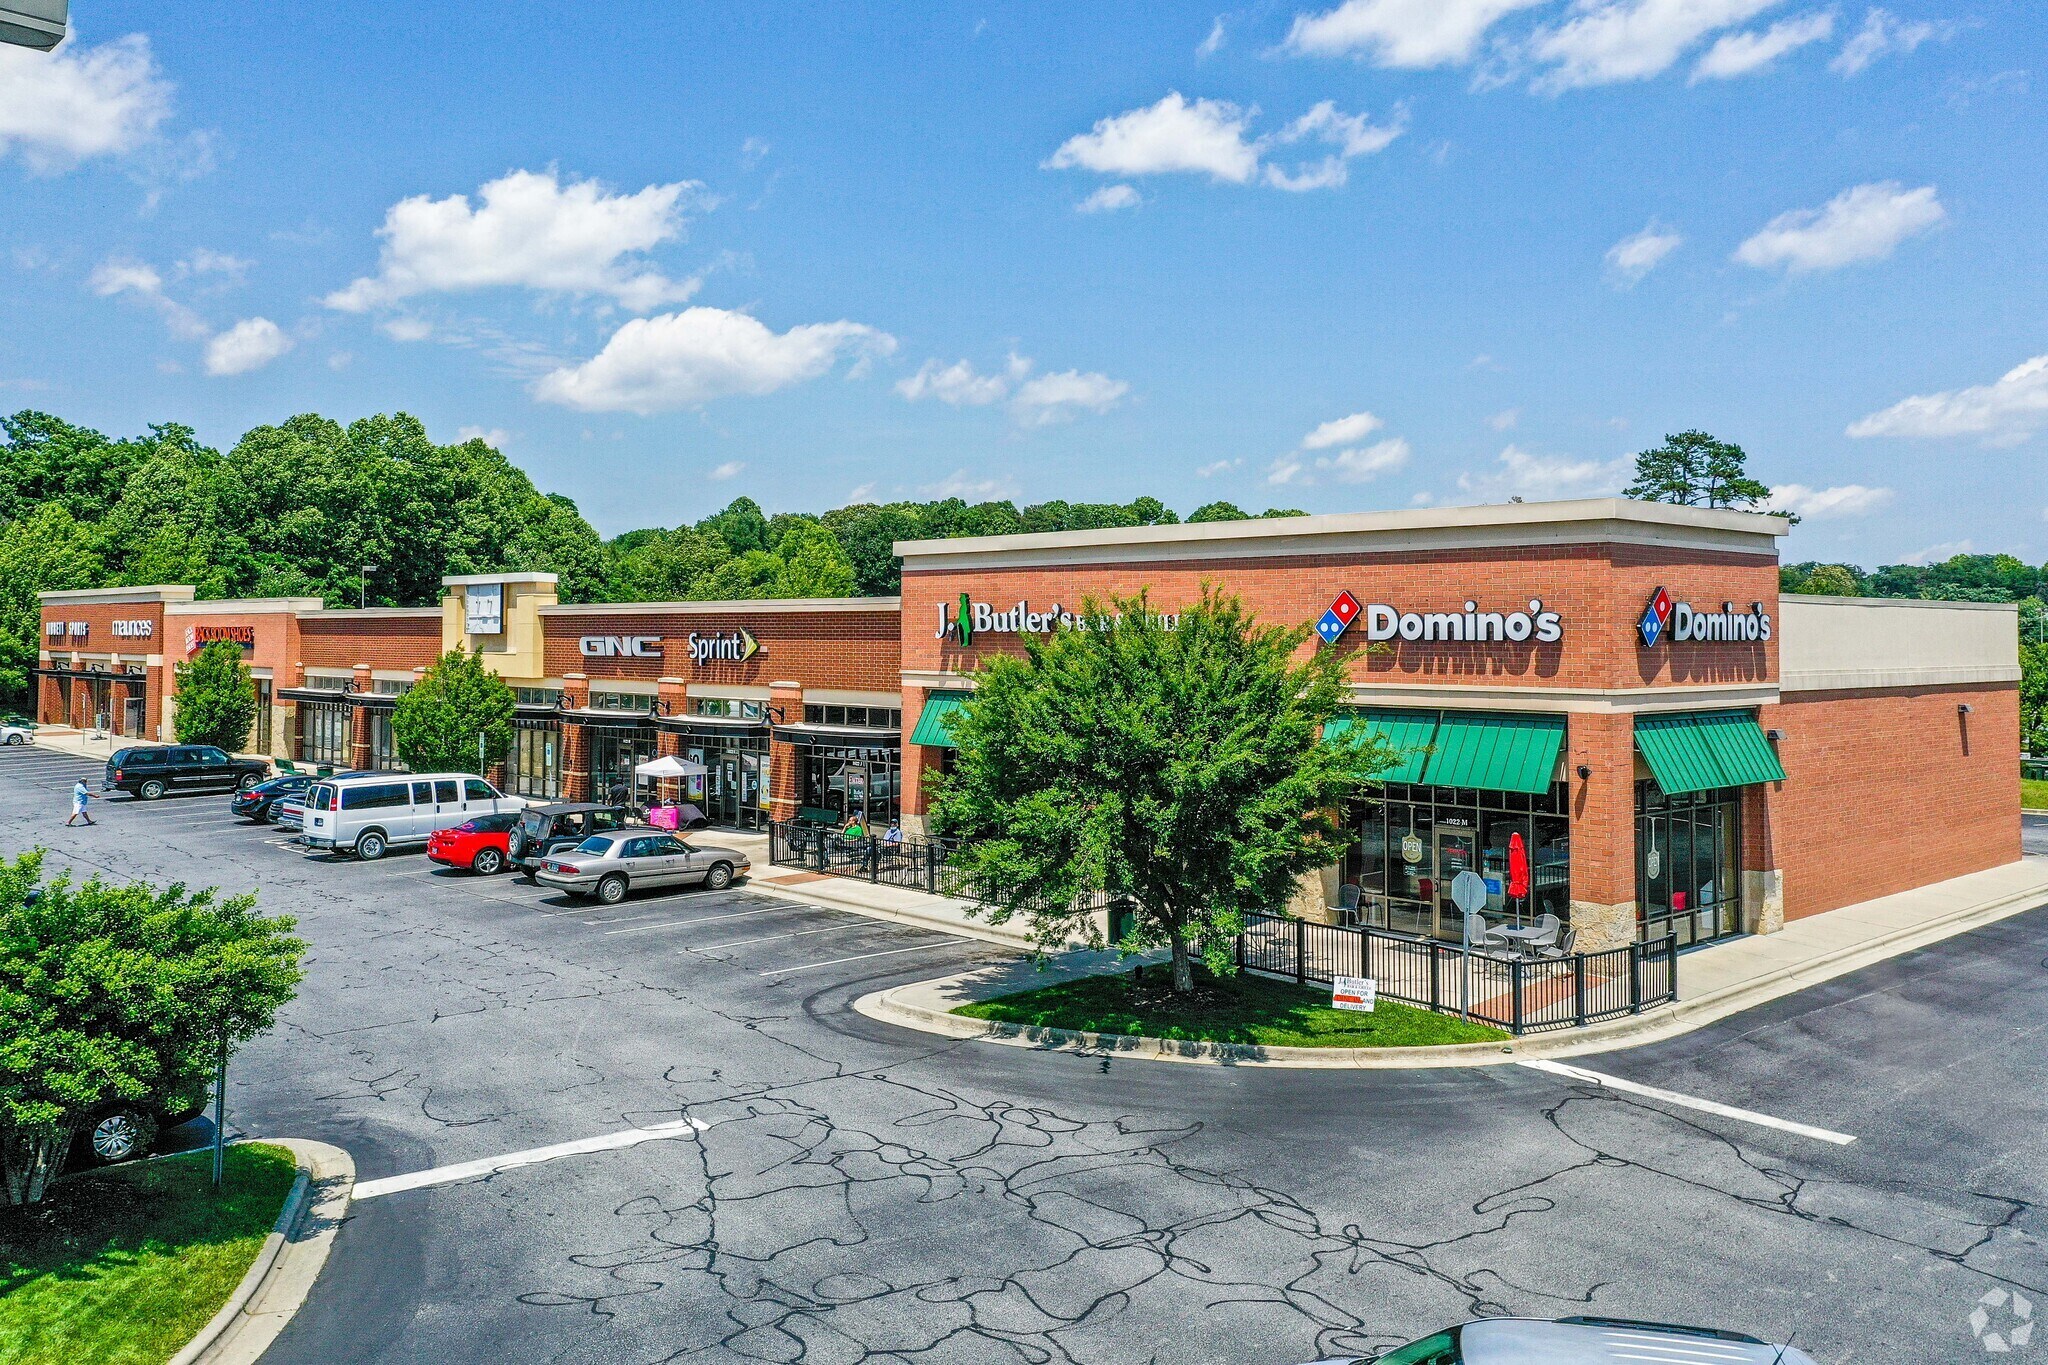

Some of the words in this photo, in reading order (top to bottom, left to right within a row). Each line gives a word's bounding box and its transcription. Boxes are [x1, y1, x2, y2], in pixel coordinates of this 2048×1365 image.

[231, 627, 251, 642] SHOES
[935, 602, 955, 639] J.
[972, 600, 1071, 633] Butler's
[1076, 614, 1110, 632] BR
[1367, 599, 1562, 642] Domino's
[1674, 601, 1771, 641] Domino's
[579, 636, 661, 657] GNC
[688, 631, 740, 666] Sprint
[1403, 841, 1421, 852] OPEN
